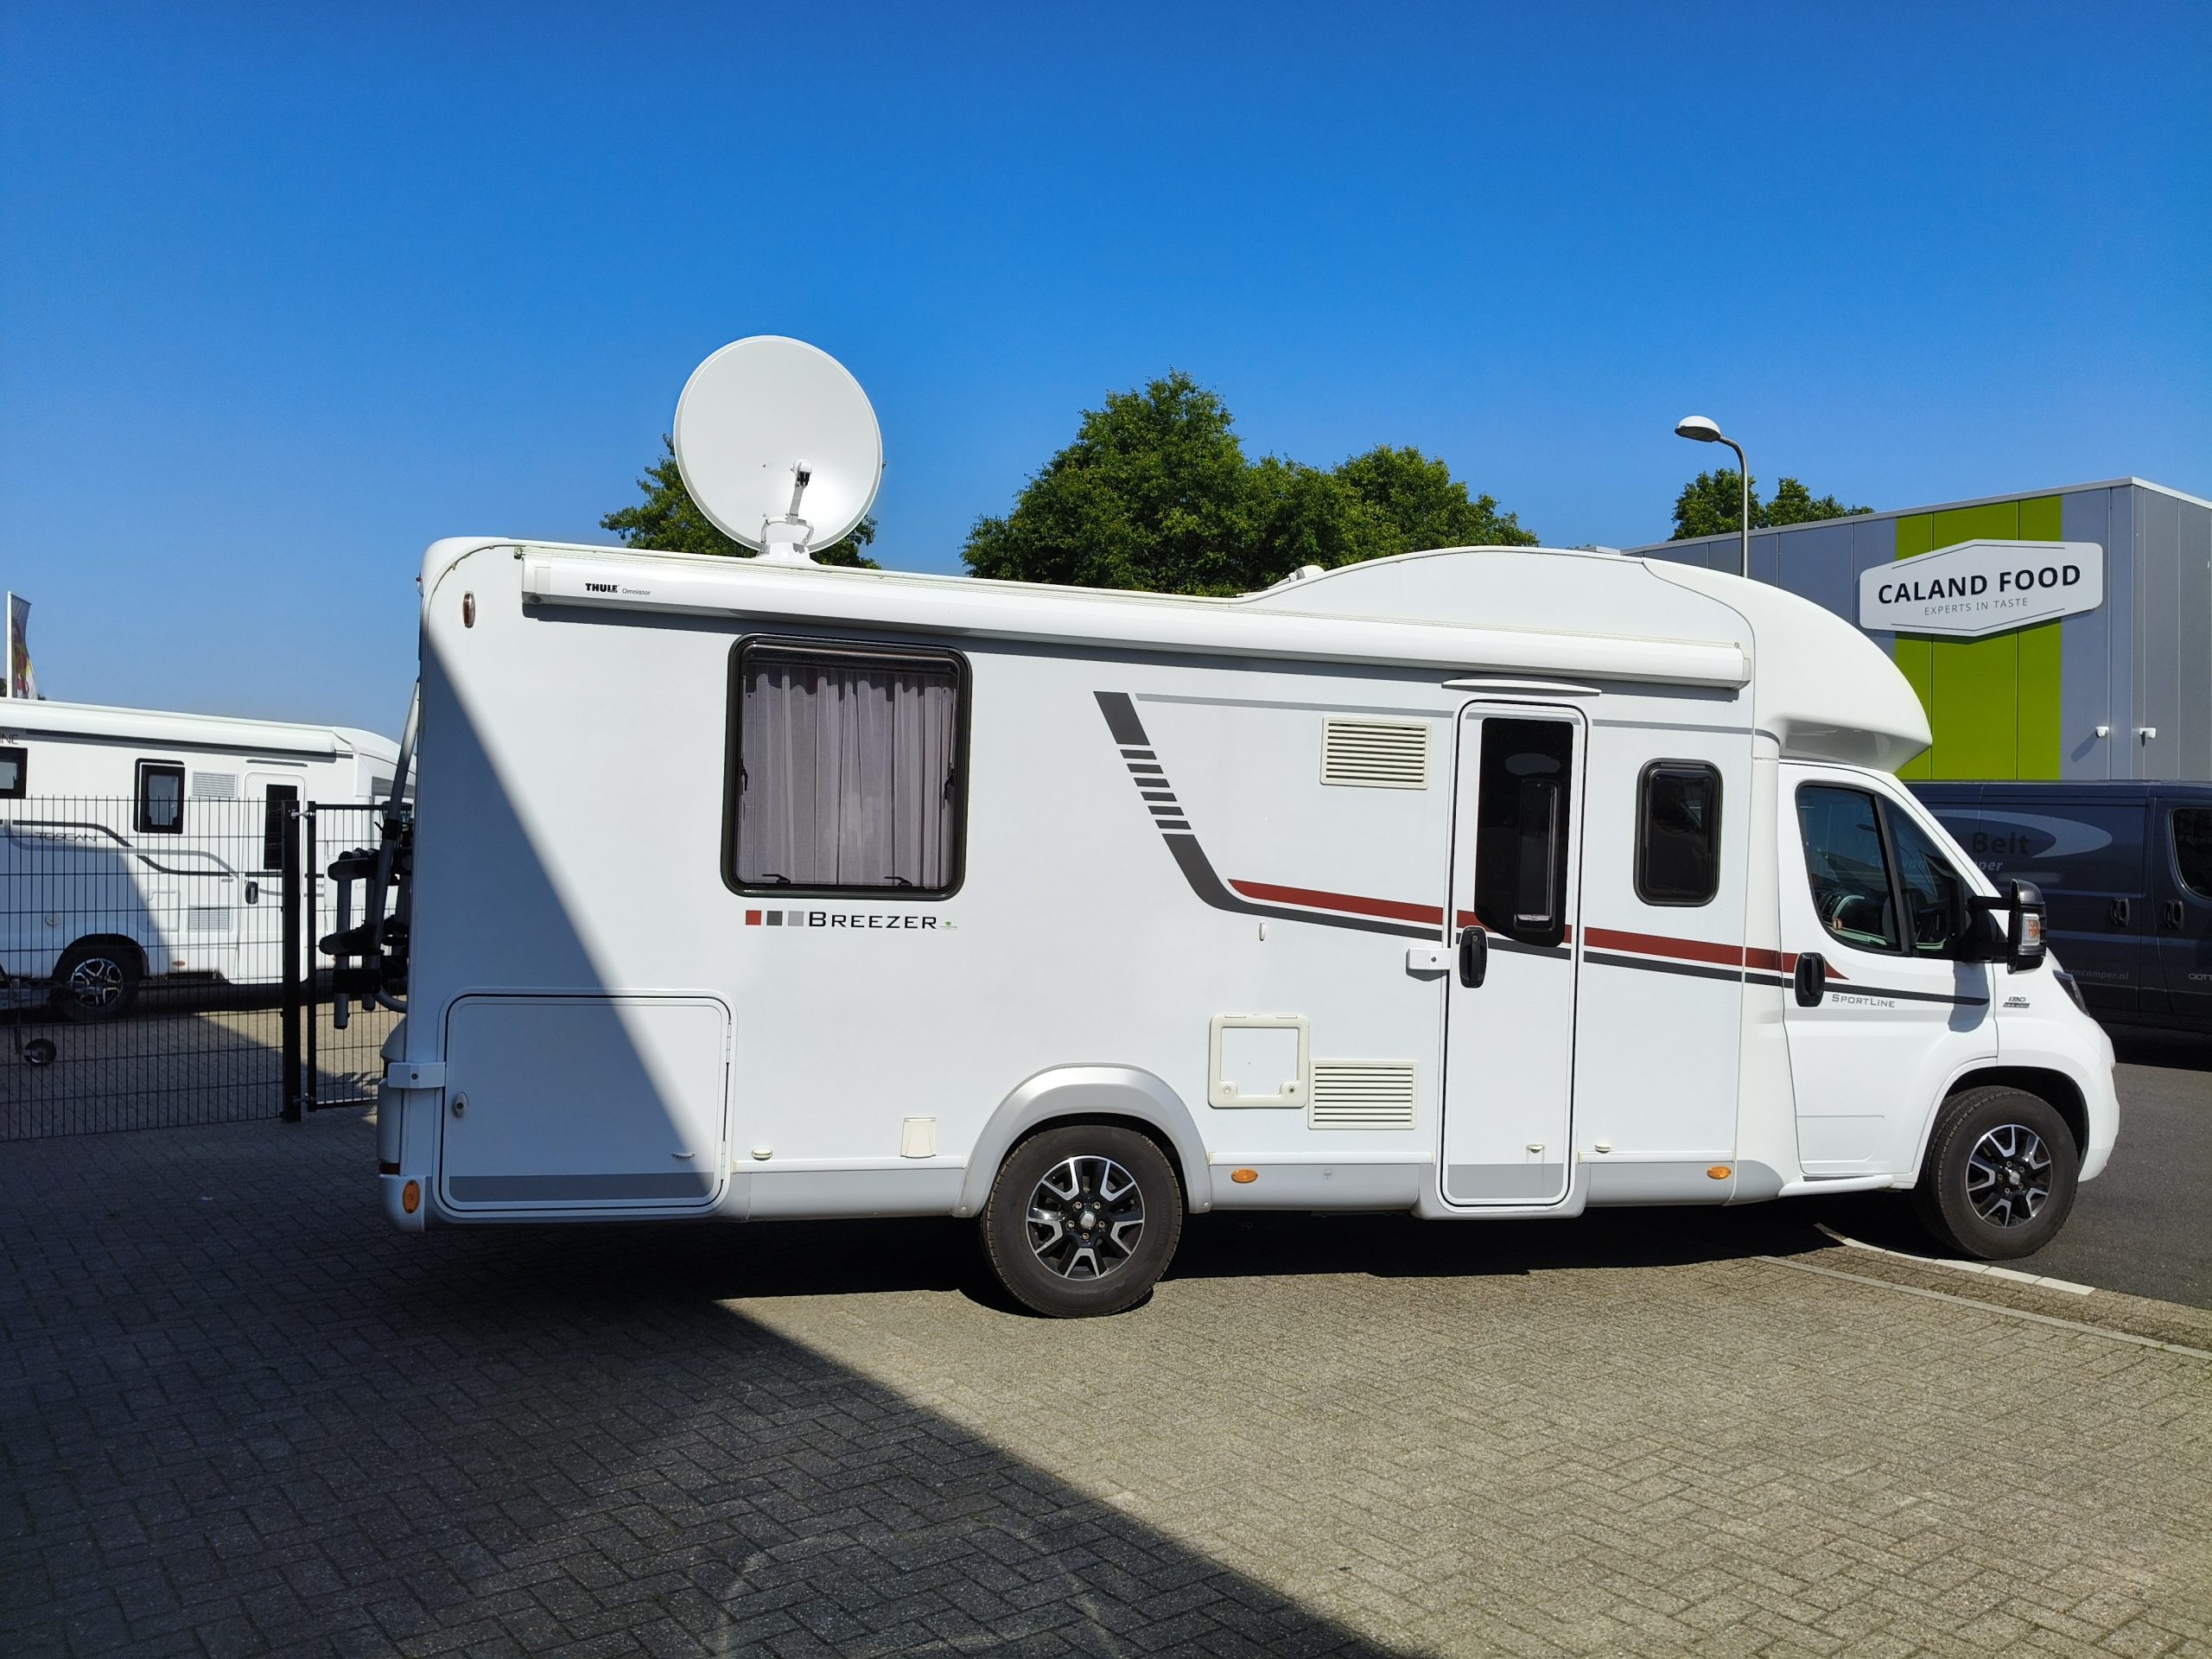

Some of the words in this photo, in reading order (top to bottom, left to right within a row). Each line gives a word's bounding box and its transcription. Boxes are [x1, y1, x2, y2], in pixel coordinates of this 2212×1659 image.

[585, 582, 618, 594] THULE
[1878, 575, 1988, 604] CALAND
[1999, 564, 2081, 593] FOOD
[1923, 603, 1972, 616] EXPERTS
[1975, 601, 1989, 611] IN
[1993, 597, 2029, 609] TASTE
[1972, 831, 2030, 856] Belt
[808, 911, 938, 930] BREEZER
